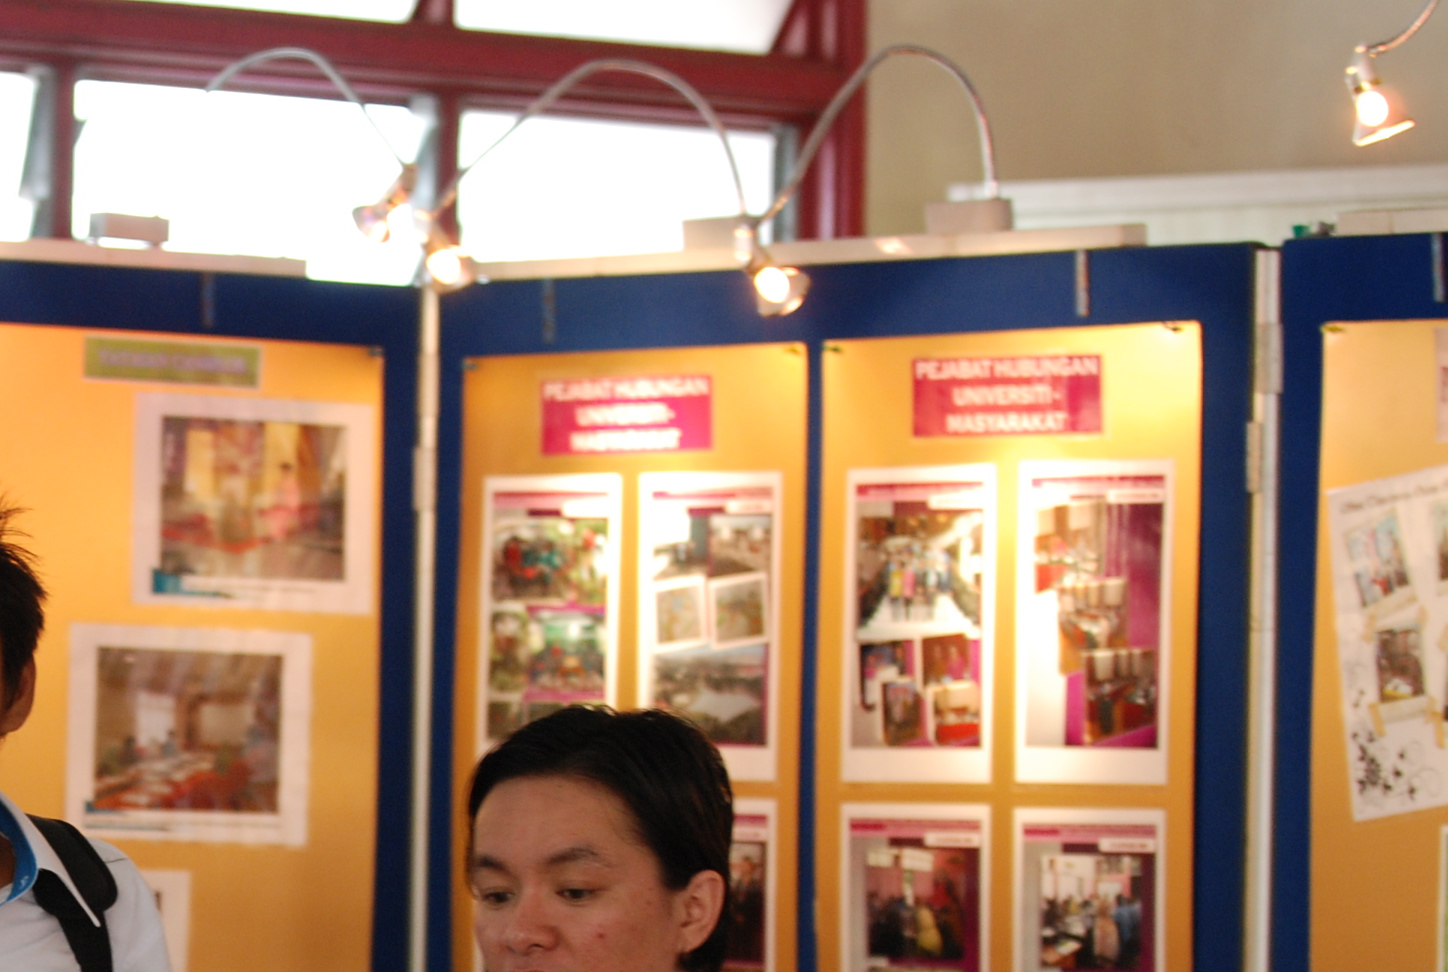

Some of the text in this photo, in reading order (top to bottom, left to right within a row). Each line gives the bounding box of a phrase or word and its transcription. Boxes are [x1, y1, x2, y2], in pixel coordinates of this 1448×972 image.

[915, 357, 1098, 380] PEJABAT HUBUNGAN
[946, 411, 1067, 434] MASYARAKAT
